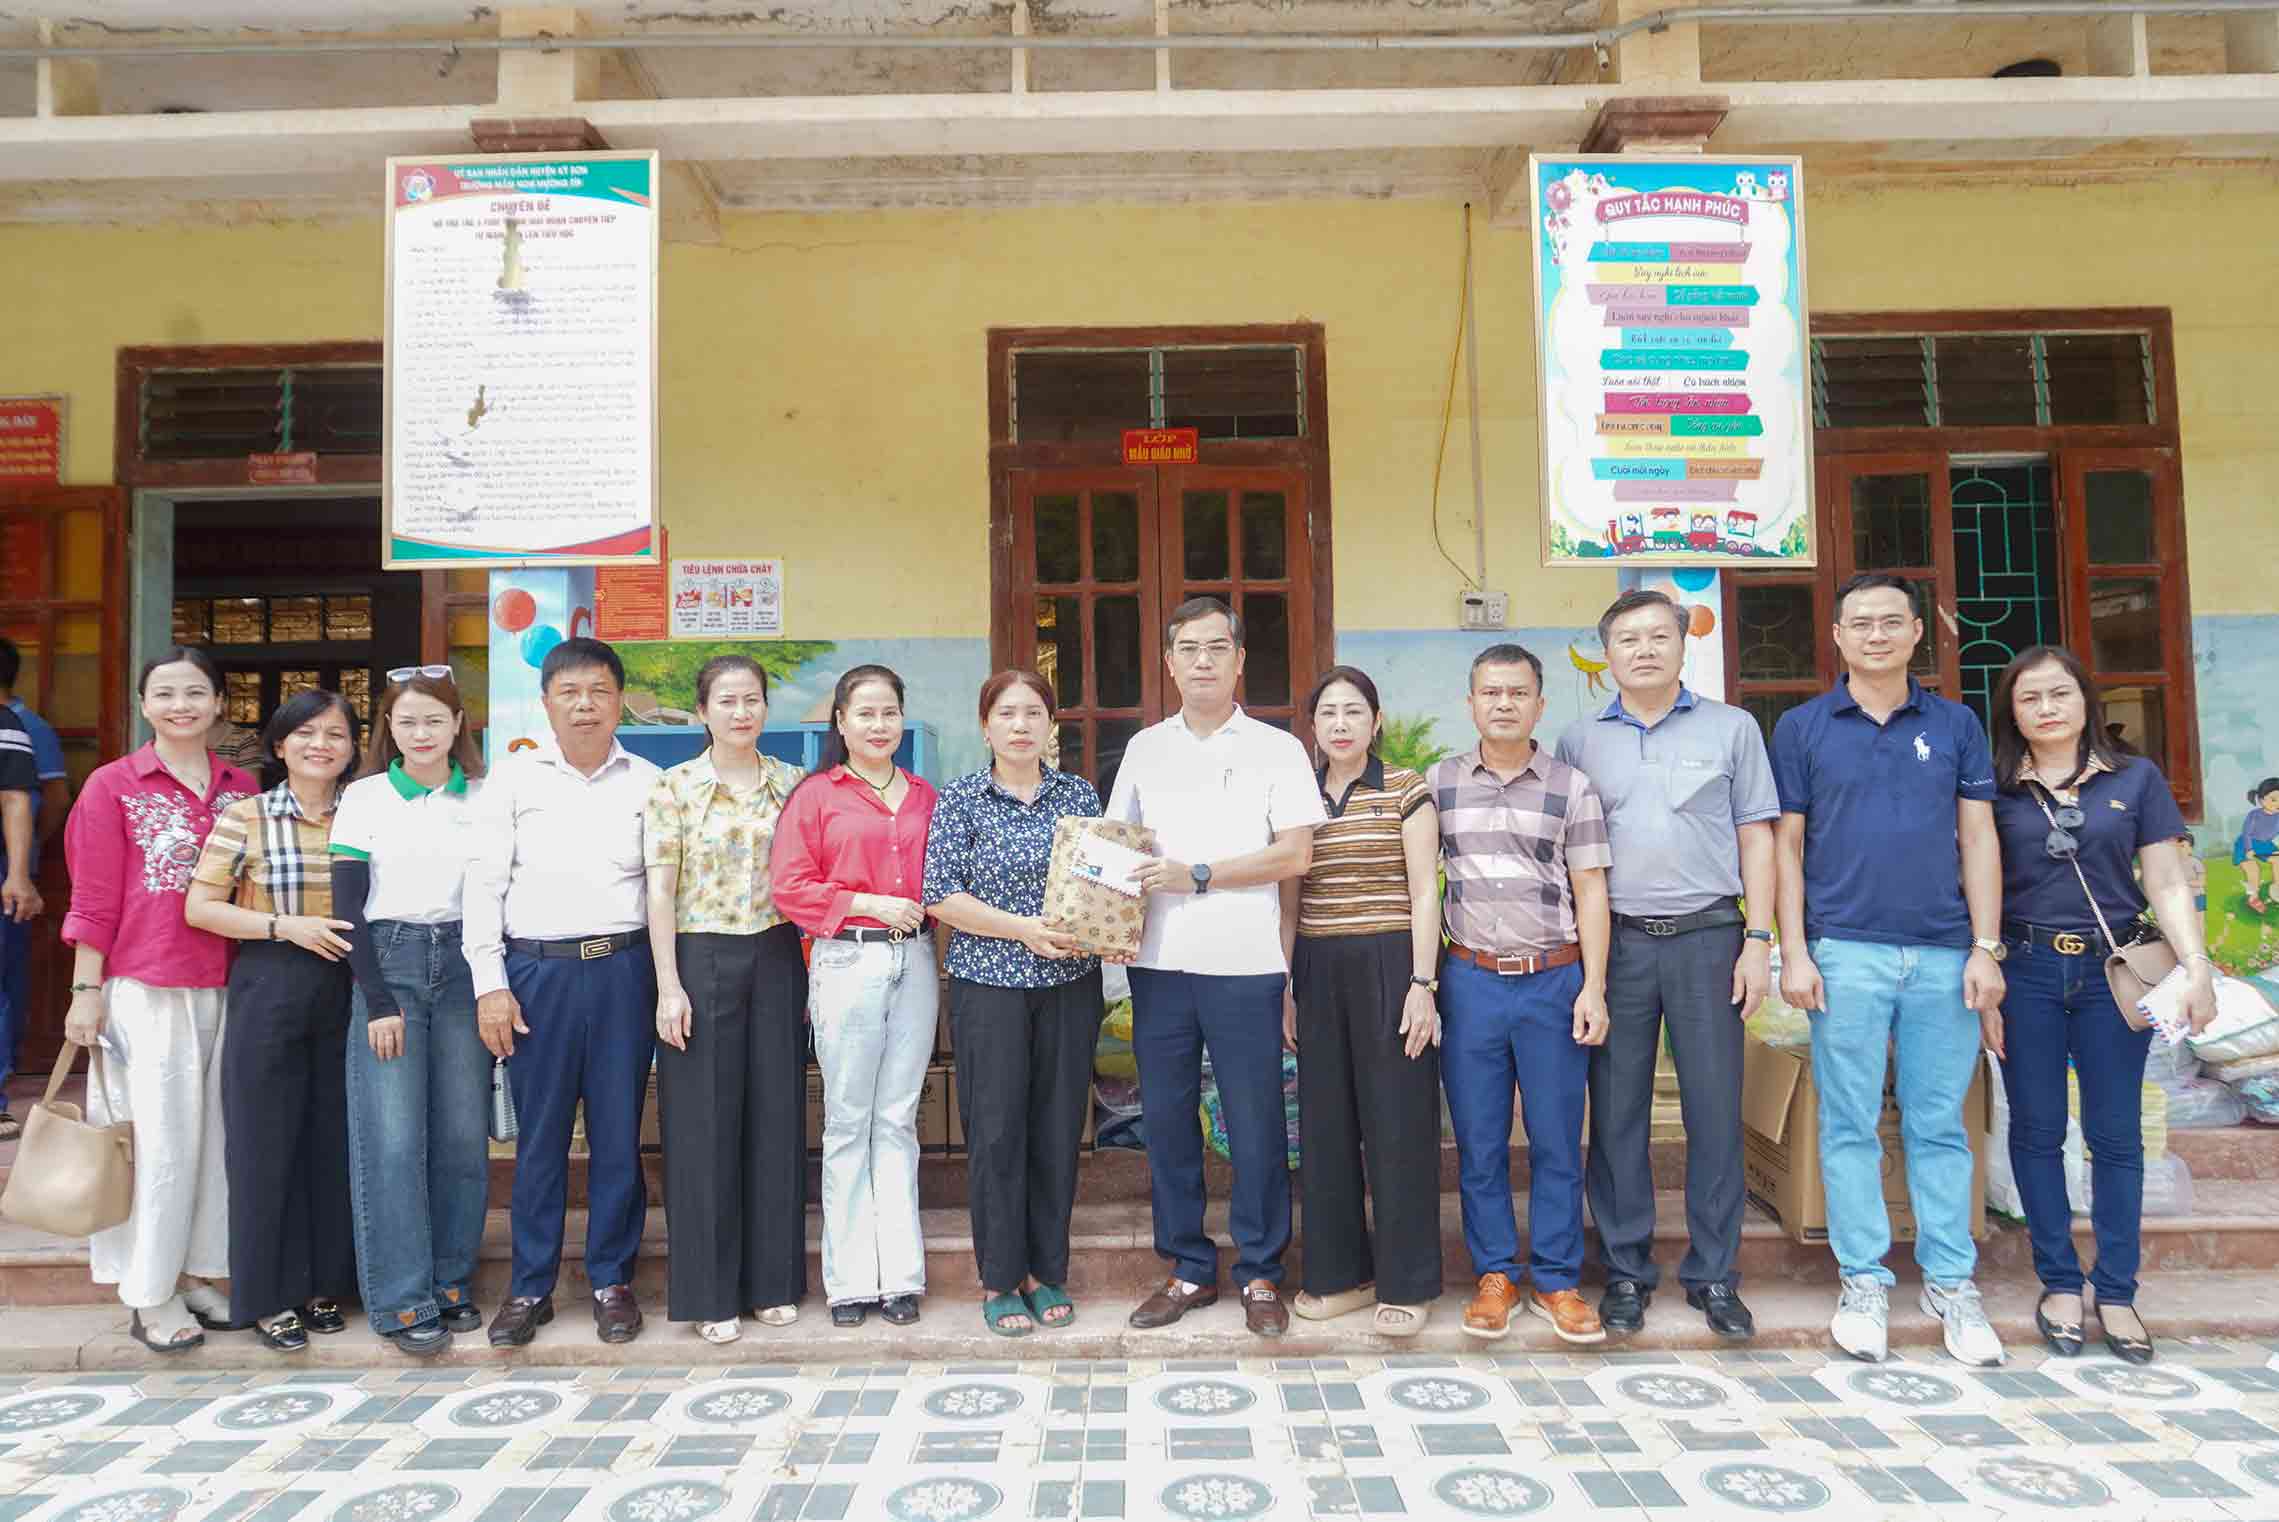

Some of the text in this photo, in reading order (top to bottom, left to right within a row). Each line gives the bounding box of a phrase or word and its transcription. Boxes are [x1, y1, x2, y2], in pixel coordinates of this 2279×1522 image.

[1604, 195, 1741, 217] QUY TẮC HẠNH PHÚC
[702, 562, 724, 576] LỆNH
